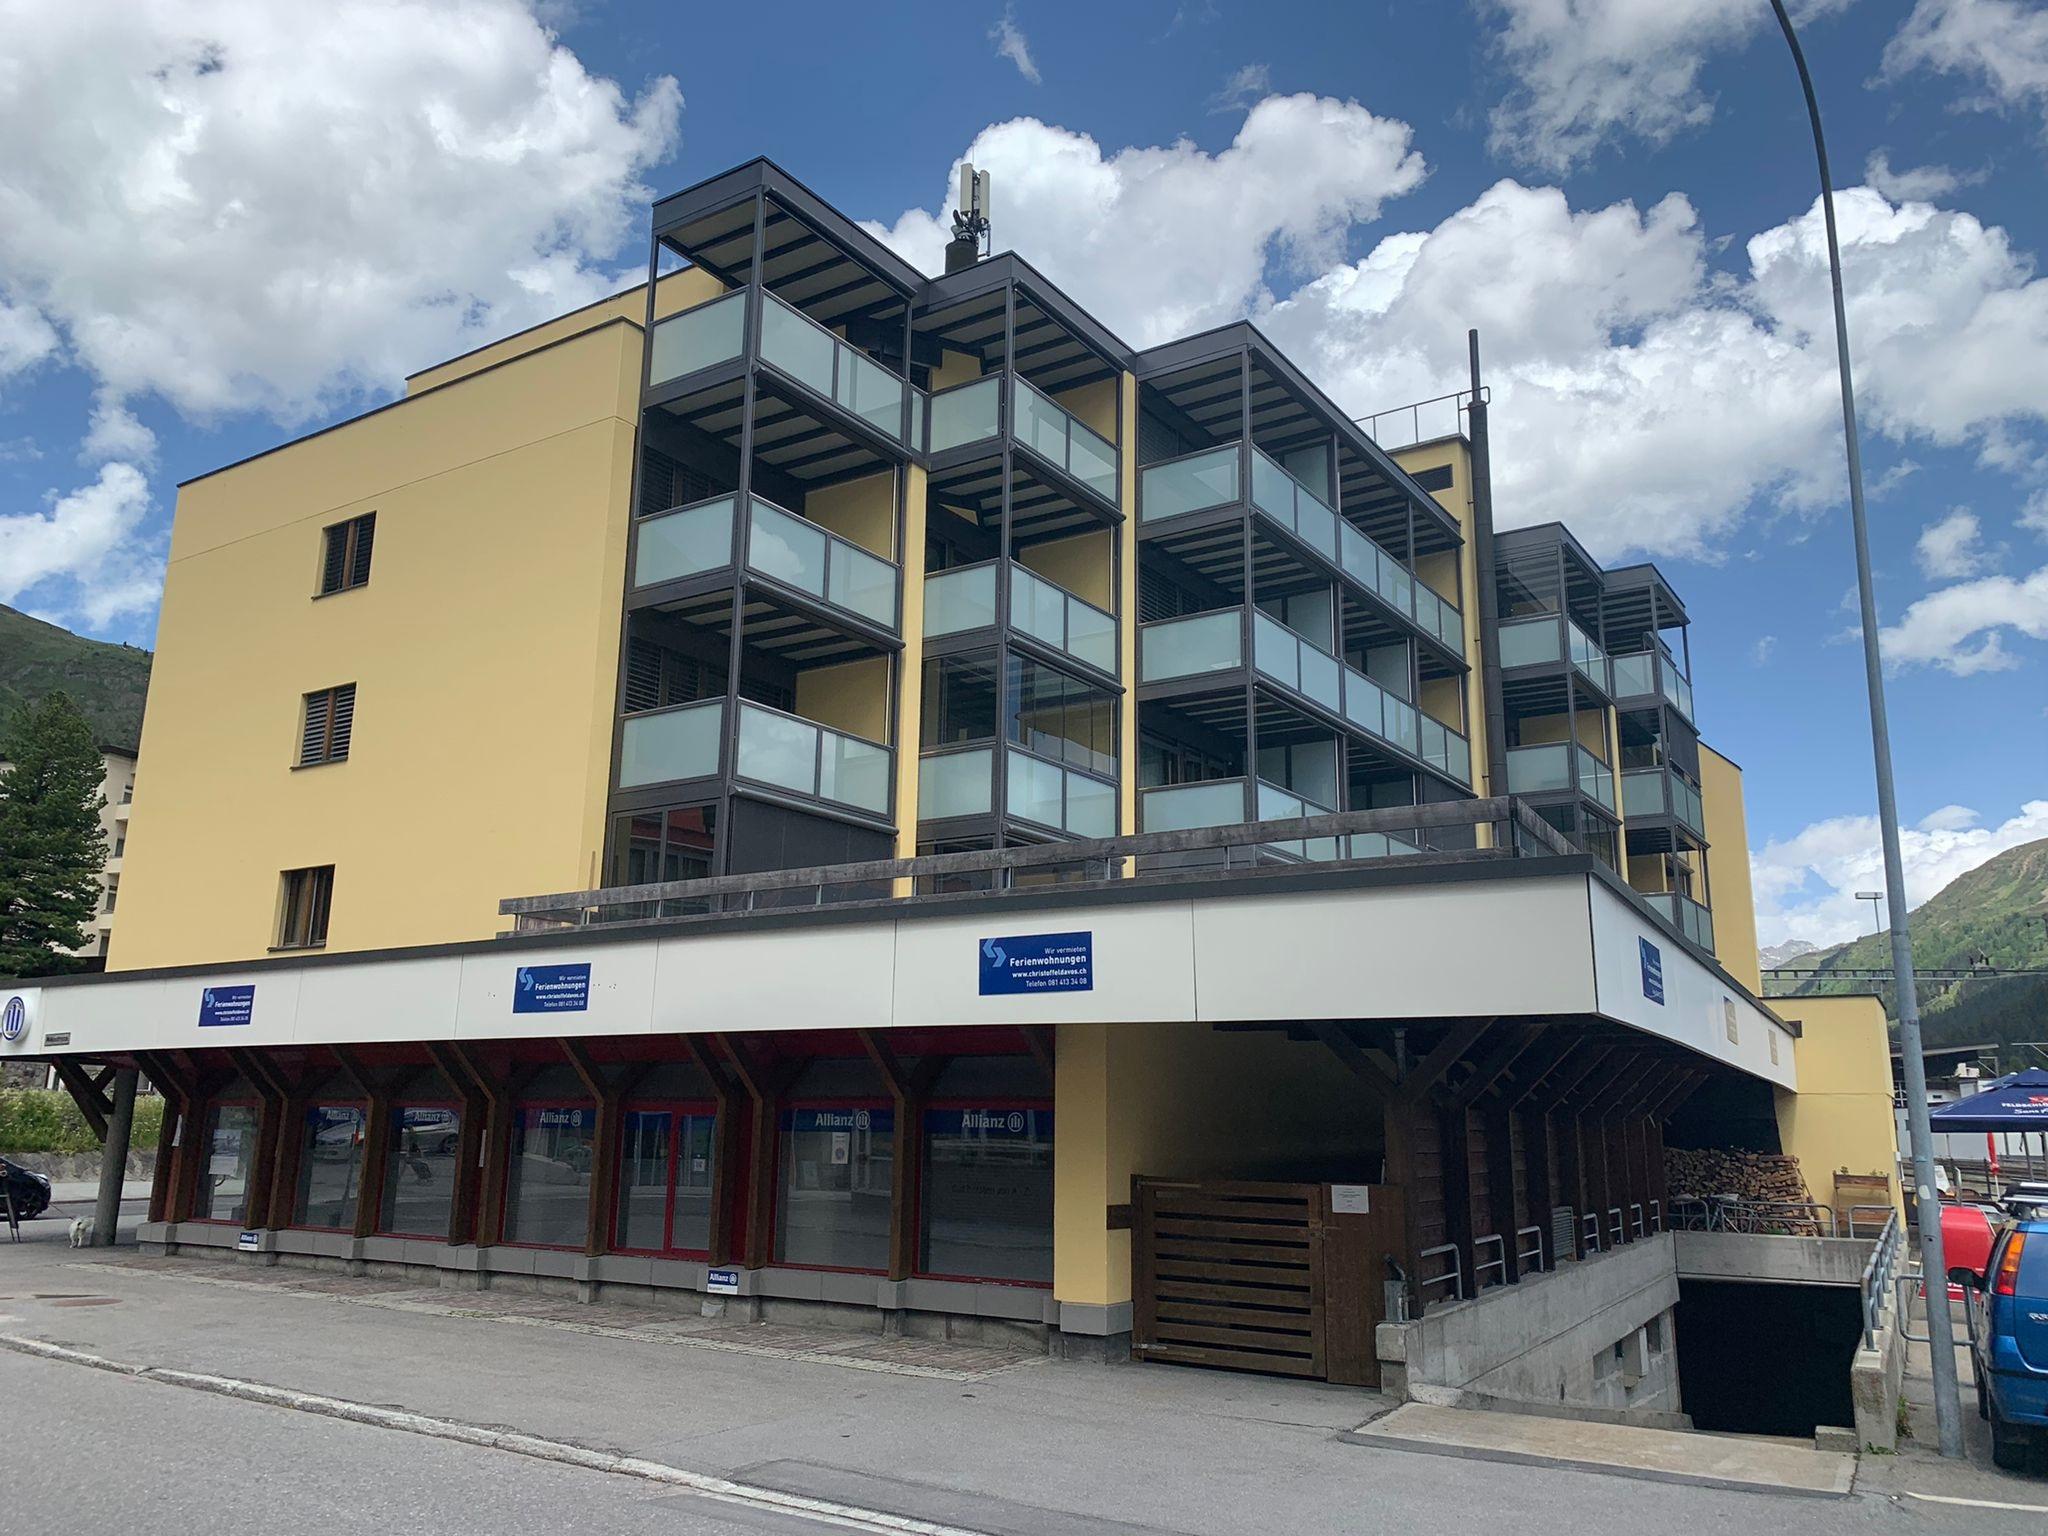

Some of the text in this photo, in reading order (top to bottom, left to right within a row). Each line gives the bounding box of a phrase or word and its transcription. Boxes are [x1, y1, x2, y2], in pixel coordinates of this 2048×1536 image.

[1056, 946, 1087, 954] vermieten
[1009, 955, 1087, 967] Ferienwohnungen
[1012, 967, 1087, 978] www.christoffeldavos.ch
[534, 982, 586, 991] Ferienwohnungen
[1059, 978, 1070, 986] 413
[326, 1109, 350, 1121] Allianz
[414, 1110, 440, 1122] Allianz
[540, 1111, 570, 1124] Allianz
[815, 1113, 854, 1127] Allianz
[961, 1114, 1005, 1128] Allianz
[709, 1272, 729, 1282] Allianz
